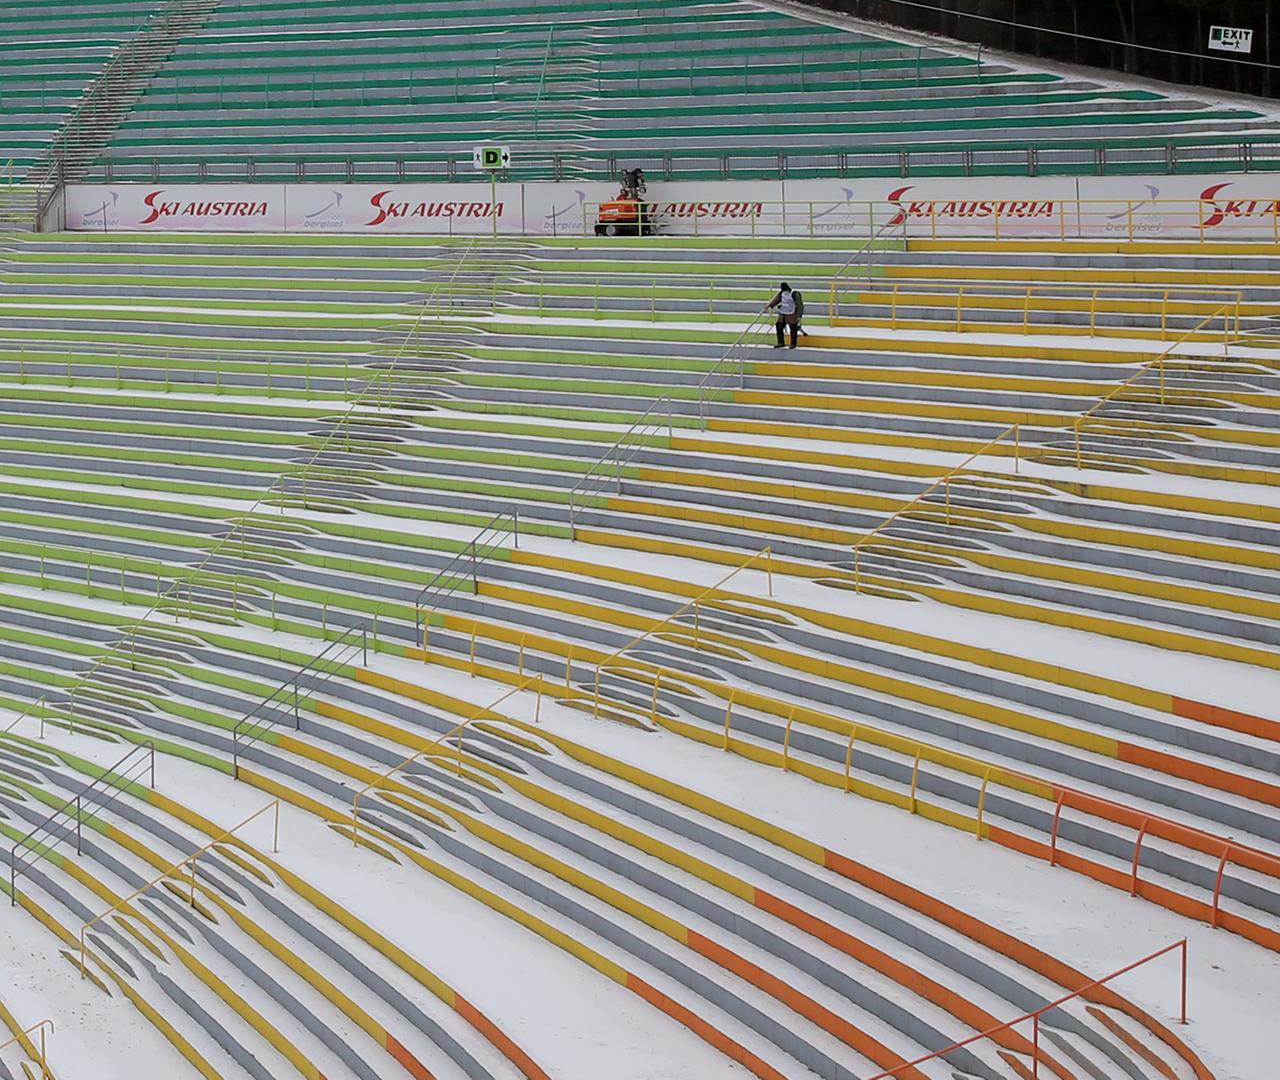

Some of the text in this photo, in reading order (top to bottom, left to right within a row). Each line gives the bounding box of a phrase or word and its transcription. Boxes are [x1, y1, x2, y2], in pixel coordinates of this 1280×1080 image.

[1224, 29, 1251, 40] EXIT
[486, 152, 498, 163] D
[138, 190, 268, 224] SKI AUSTRIA
[364, 190, 504, 225] SKI AUSTRIA
[658, 203, 763, 218] AUSTRIA
[881, 185, 1055, 227] SKI AUSTRIA
[1190, 182, 1257, 229] SKI
